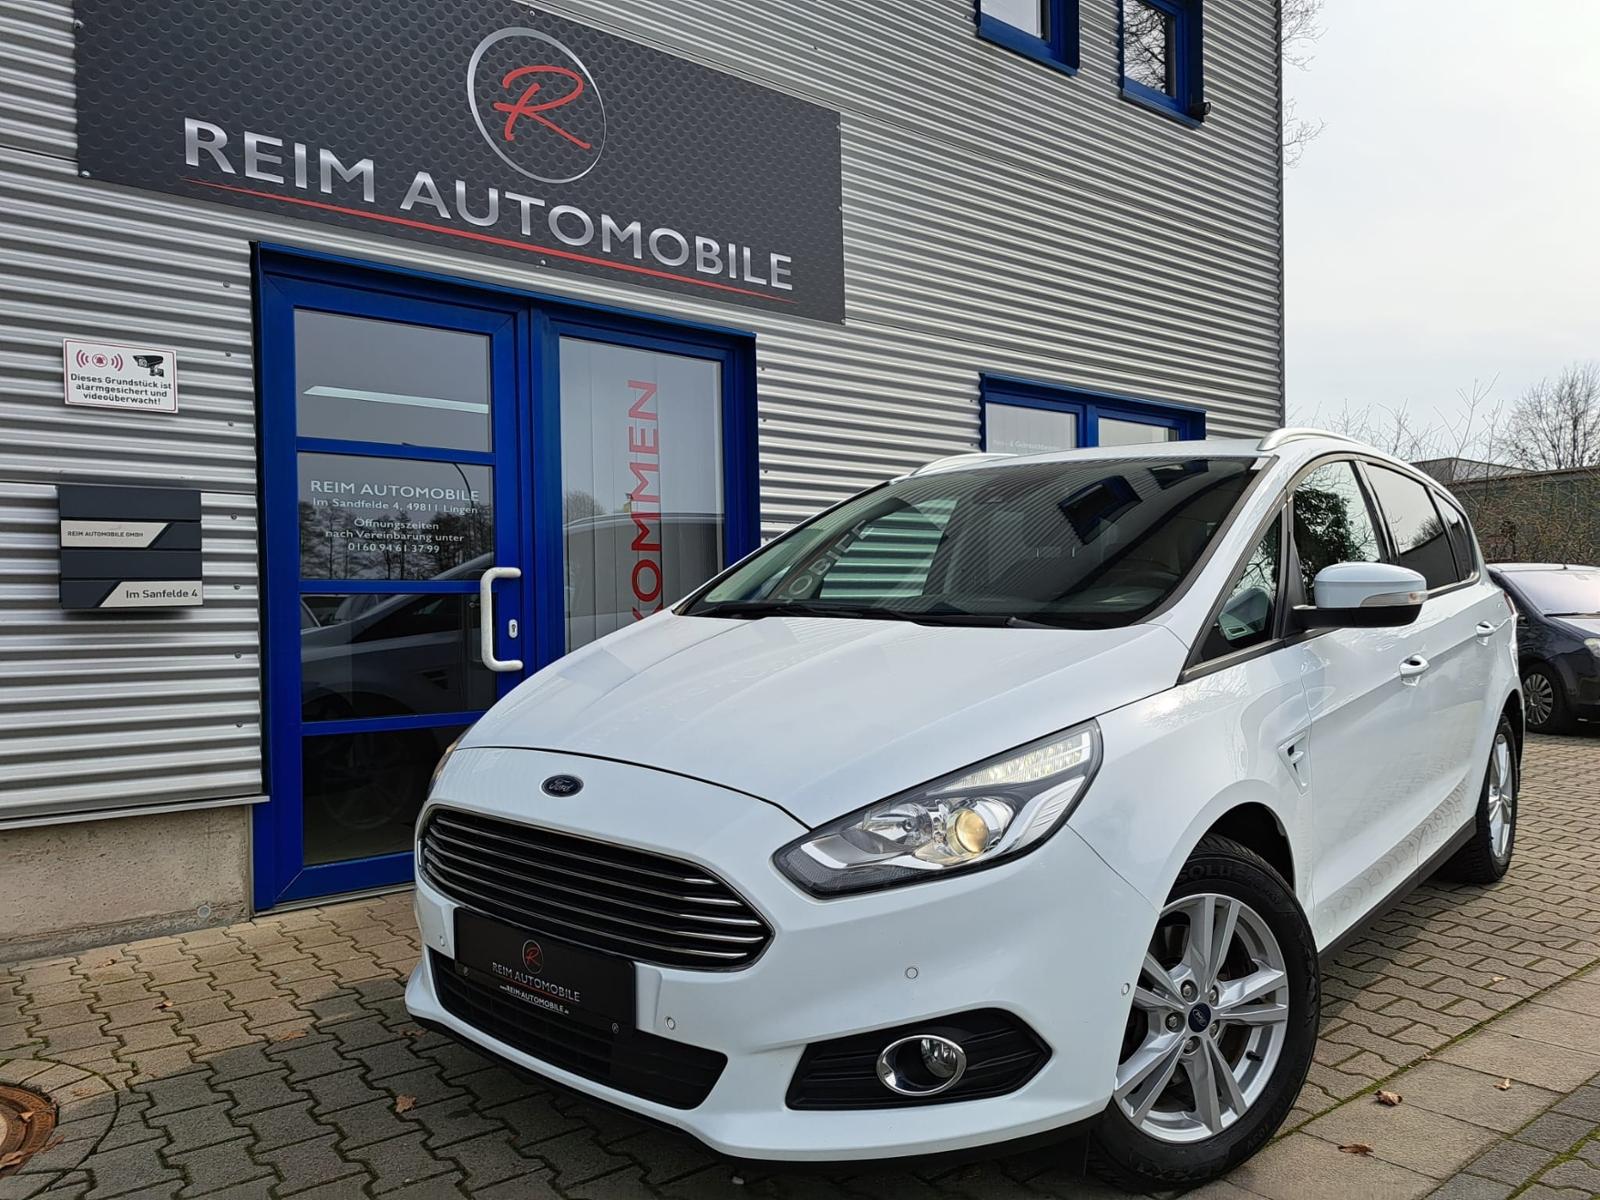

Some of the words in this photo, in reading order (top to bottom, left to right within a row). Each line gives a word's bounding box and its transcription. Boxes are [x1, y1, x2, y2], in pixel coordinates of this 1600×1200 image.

[493, 64, 592, 151] R
[184, 117, 376, 204] REIM
[400, 170, 794, 292] AUTOMOBILE
[70, 373, 103, 383] Dieses
[104, 376, 158, 389] Grundstück
[160, 381, 172, 390] ist
[75, 382, 148, 396] alarmgesichert
[150, 389, 167, 398] und
[83, 391, 162, 406] videoüberwacht!
[311, 480, 356, 495] REIM
[359, 483, 480, 502] AUTOMOBILE
[312, 498, 329, 507] Im
[332, 498, 389, 510] Sandfelde
[406, 502, 438, 512] 49811
[443, 504, 478, 516] Lingen
[84, 530, 125, 538] AUTOMOBILE
[325, 529, 353, 539] nach
[355, 530, 432, 544] Vereinbarung
[435, 533, 465, 543] unter
[126, 590, 140, 599] Im
[142, 588, 189, 599] Sanfelde
[191, 588, 199, 598] 4
[492, 962, 513, 979] REIM
[514, 970, 582, 1002] AUTOMOBILE
